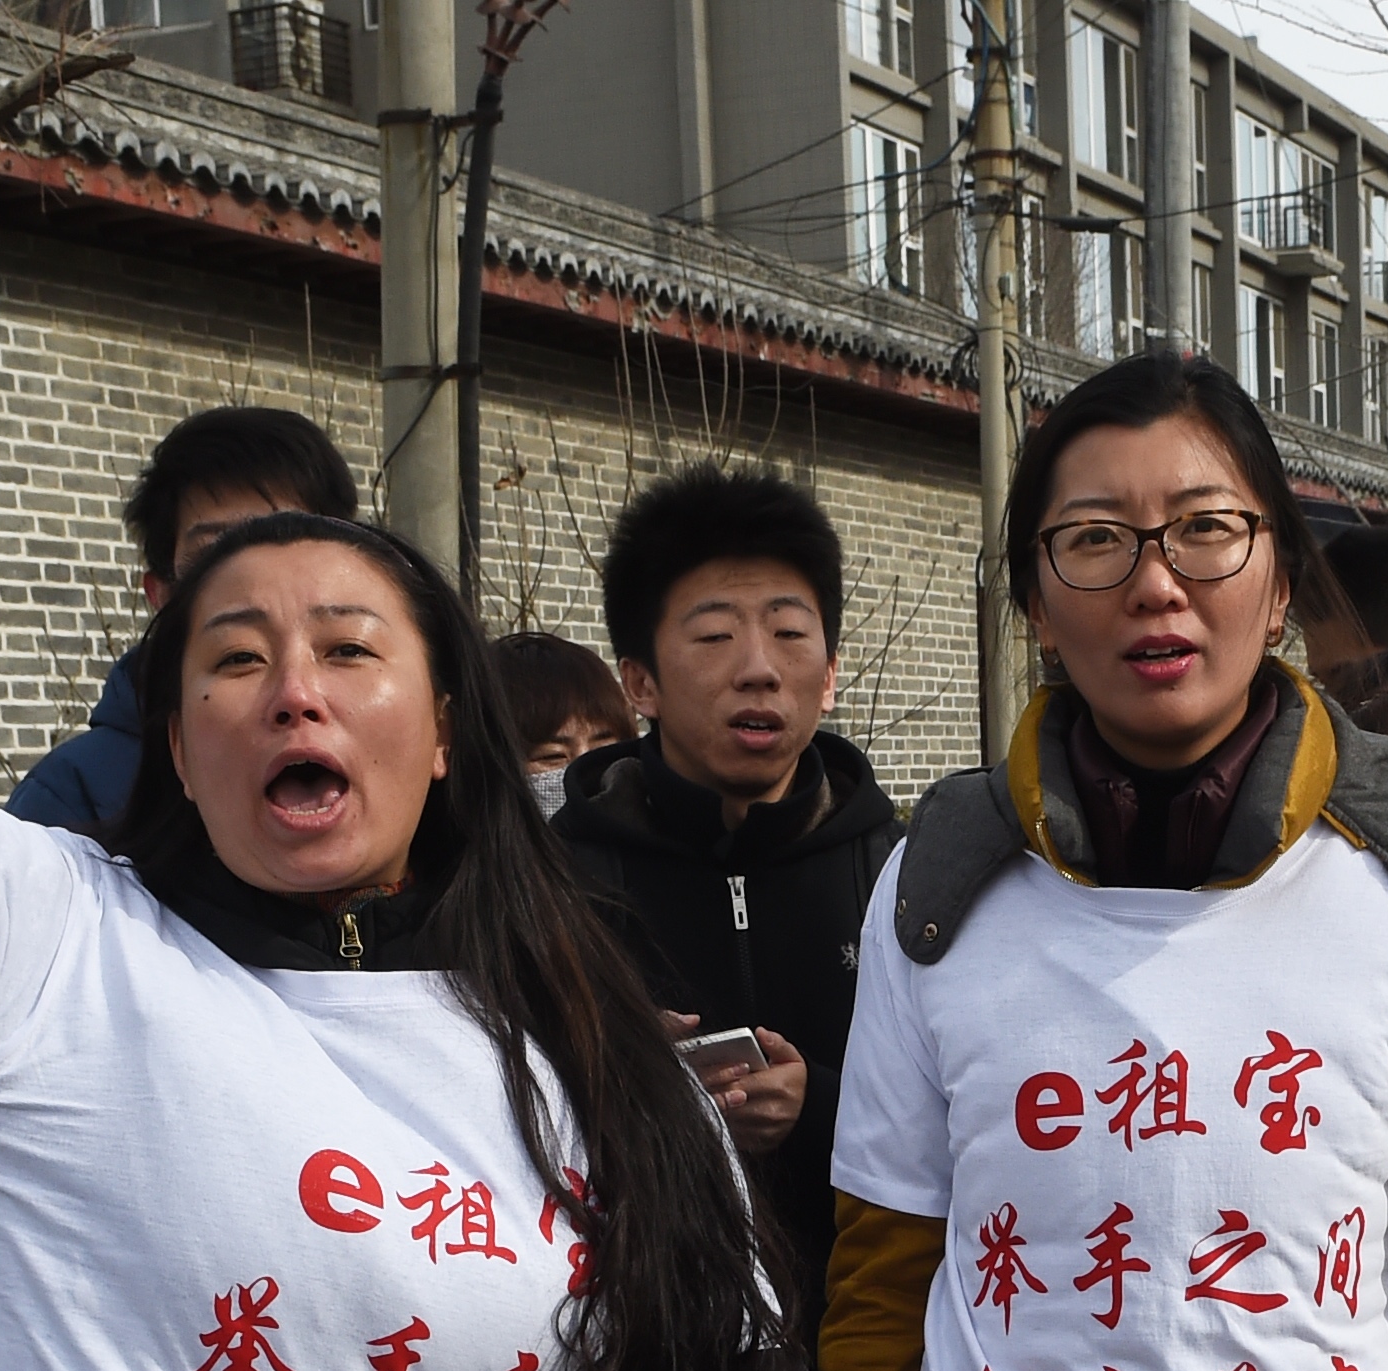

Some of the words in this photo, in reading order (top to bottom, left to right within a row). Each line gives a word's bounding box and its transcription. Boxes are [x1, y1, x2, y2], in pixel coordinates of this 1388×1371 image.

[1015, 1030, 1323, 1154] e租宝
[974, 1202, 1365, 1336] 举手之间
